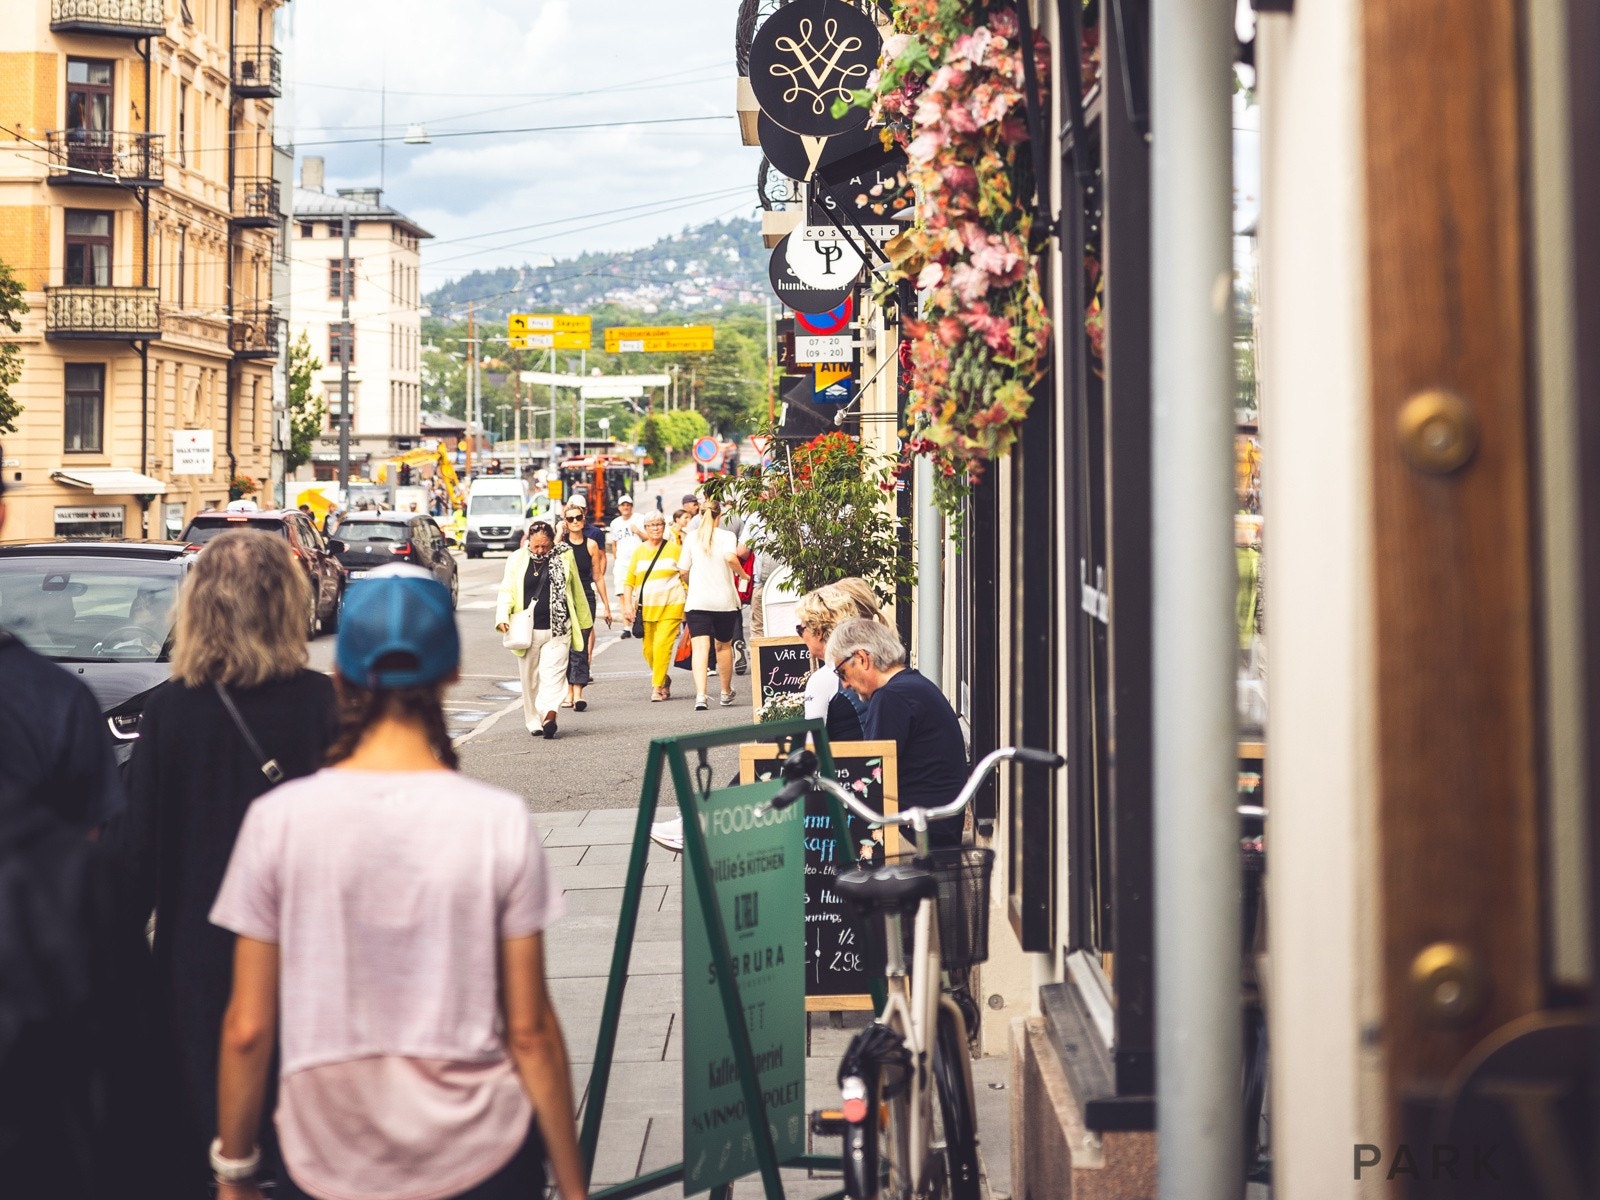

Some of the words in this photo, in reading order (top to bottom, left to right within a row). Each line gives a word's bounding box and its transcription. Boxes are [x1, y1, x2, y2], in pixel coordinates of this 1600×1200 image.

[806, 227, 896, 237] costic
[809, 338, 819, 346] 07
[829, 337, 840, 345] 20
[806, 349, 820, 358] (09
[830, 348, 844, 357] 20)
[820, 362, 852, 373] ATM
[708, 944, 785, 985] SBRURA
[703, 1081, 801, 1130] VINMOPOLET
